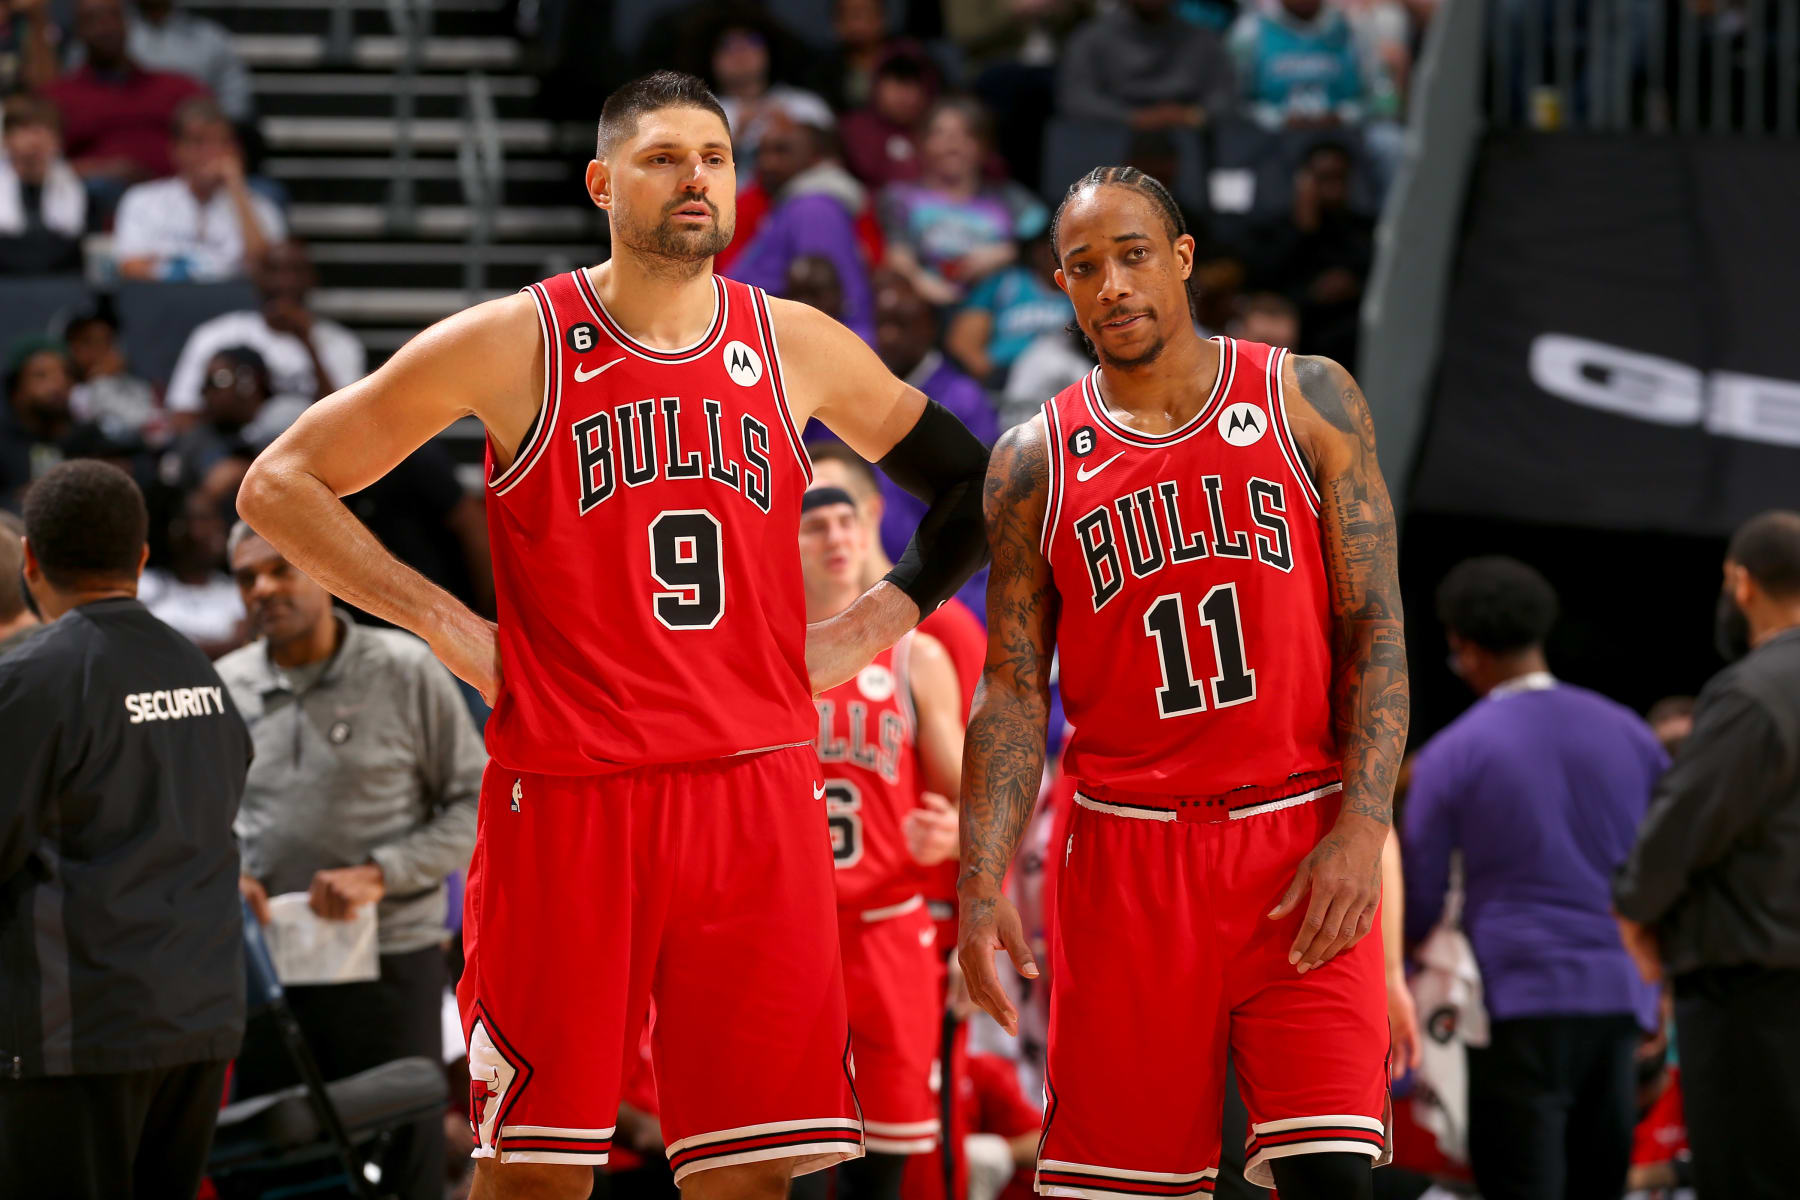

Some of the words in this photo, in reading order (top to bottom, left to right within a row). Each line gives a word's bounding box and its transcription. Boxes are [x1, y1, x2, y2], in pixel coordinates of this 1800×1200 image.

[573, 326, 592, 350] 6
[571, 396, 772, 517] BULLS
[1075, 430, 1092, 454] 6
[648, 508, 725, 631] 9
[1073, 474, 1294, 614] BULLS
[1143, 582, 1257, 720] 11
[125, 686, 225, 724] SECURITY
[816, 698, 907, 786] LLS
